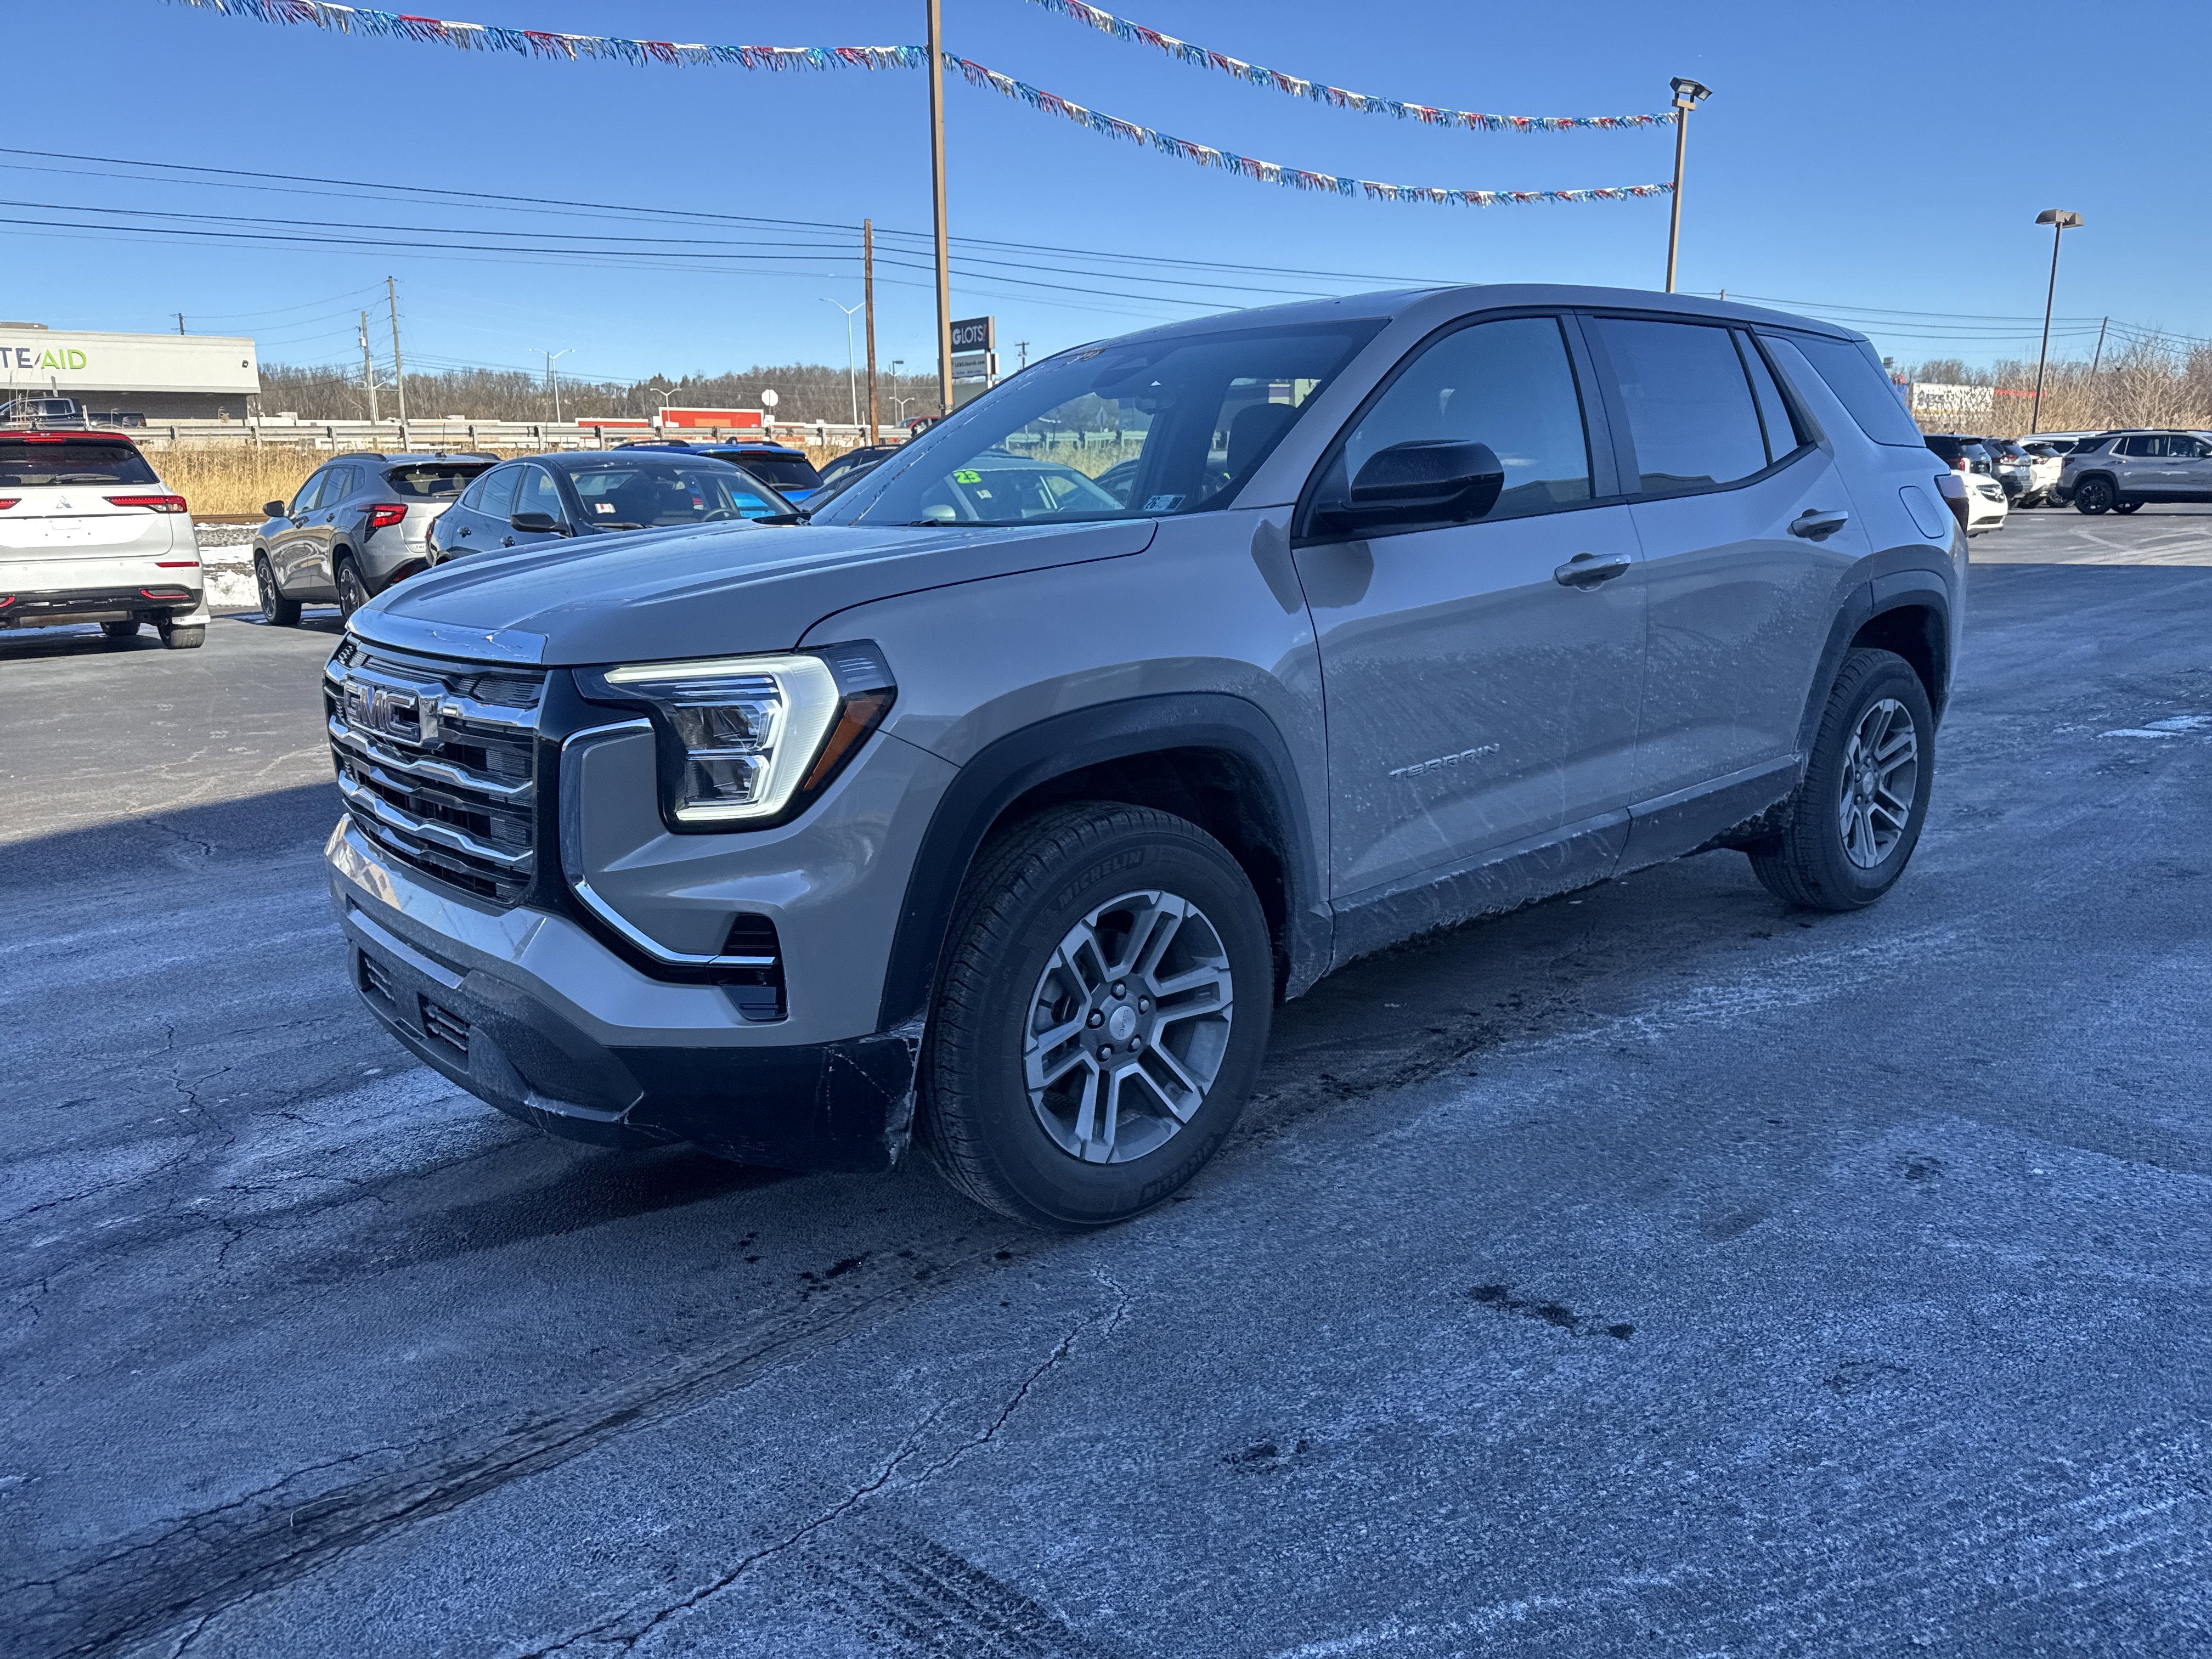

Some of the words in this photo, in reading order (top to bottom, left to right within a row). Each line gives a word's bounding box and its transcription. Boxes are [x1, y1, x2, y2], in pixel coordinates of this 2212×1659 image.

[0, 347, 33, 368] TE
[41, 348, 87, 369] AID
[953, 471, 982, 483] 23
[1144, 496, 1161, 509] 26
[344, 680, 420, 738] GMC
[1389, 743, 1500, 781] TERRAIN
[1058, 850, 1142, 906] MICHELIN
[1119, 1009, 1128, 1037] GMC
